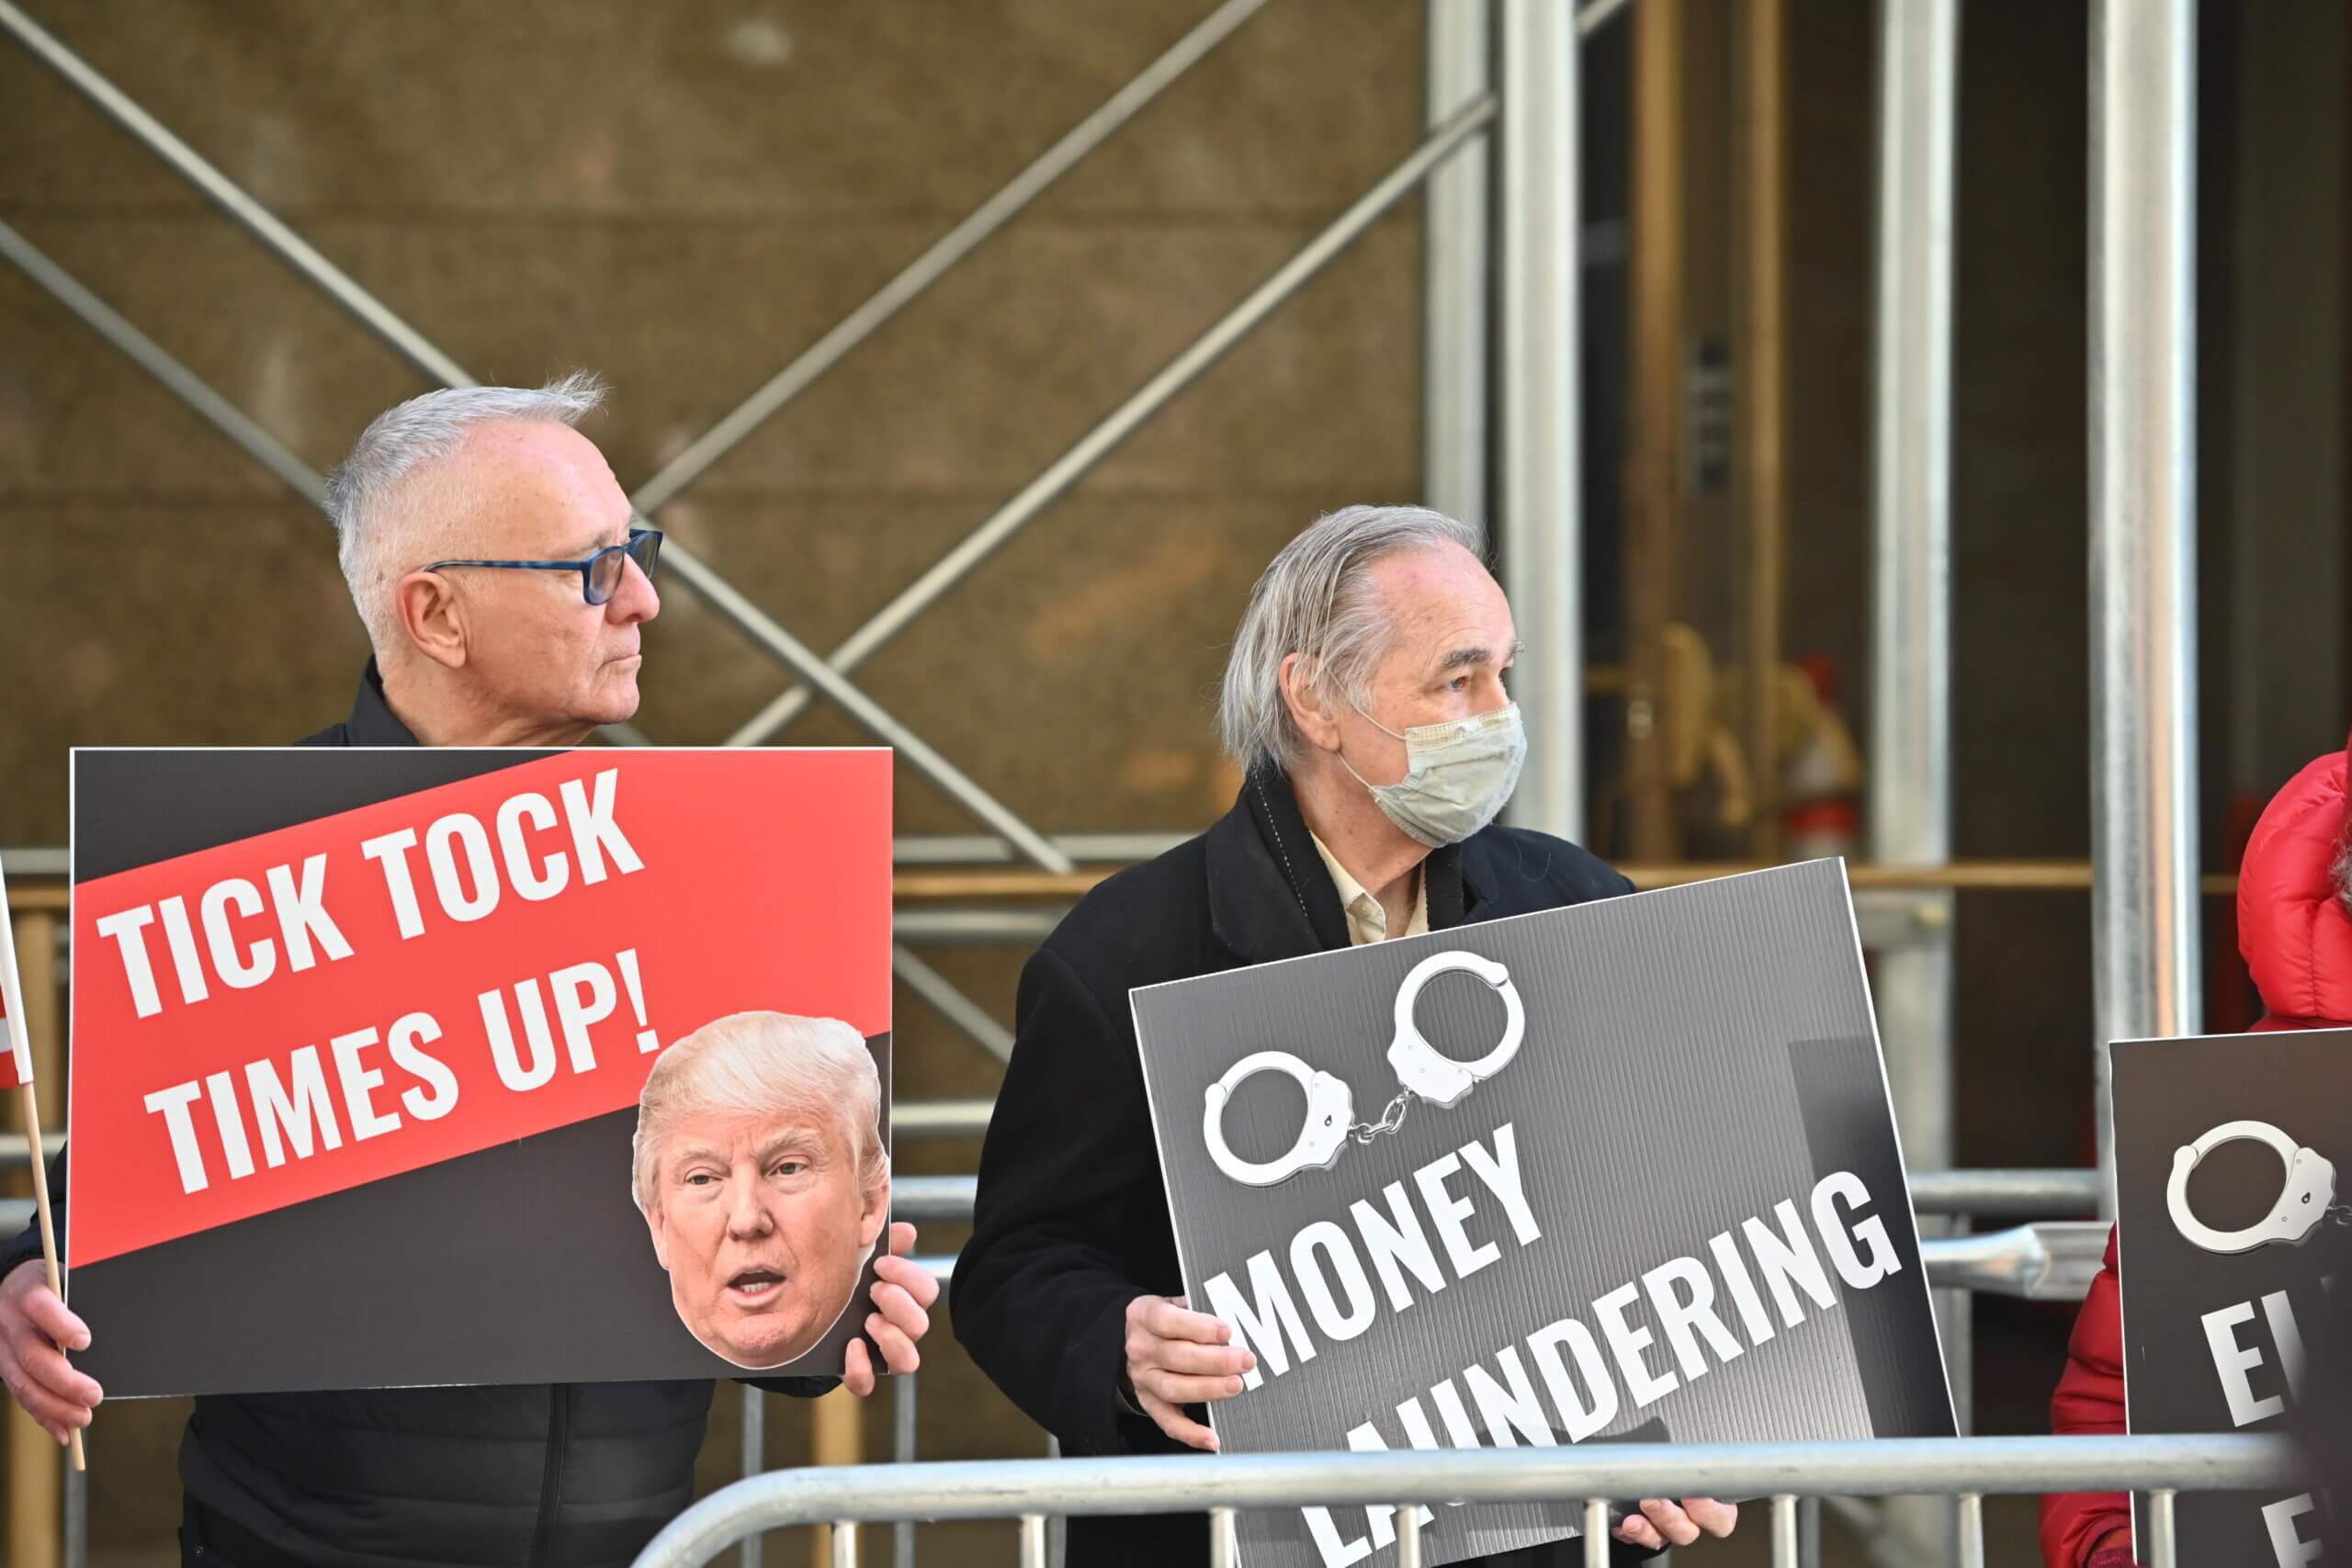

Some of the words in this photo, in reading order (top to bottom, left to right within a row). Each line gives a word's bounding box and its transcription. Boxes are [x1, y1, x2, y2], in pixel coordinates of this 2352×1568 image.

[96, 852, 355, 1019] TICK
[360, 768, 645, 940] TOCK
[143, 1011, 459, 1194] TIMES
[477, 948, 660, 1091] UP!
[1204, 1122, 1542, 1392] MONEY
